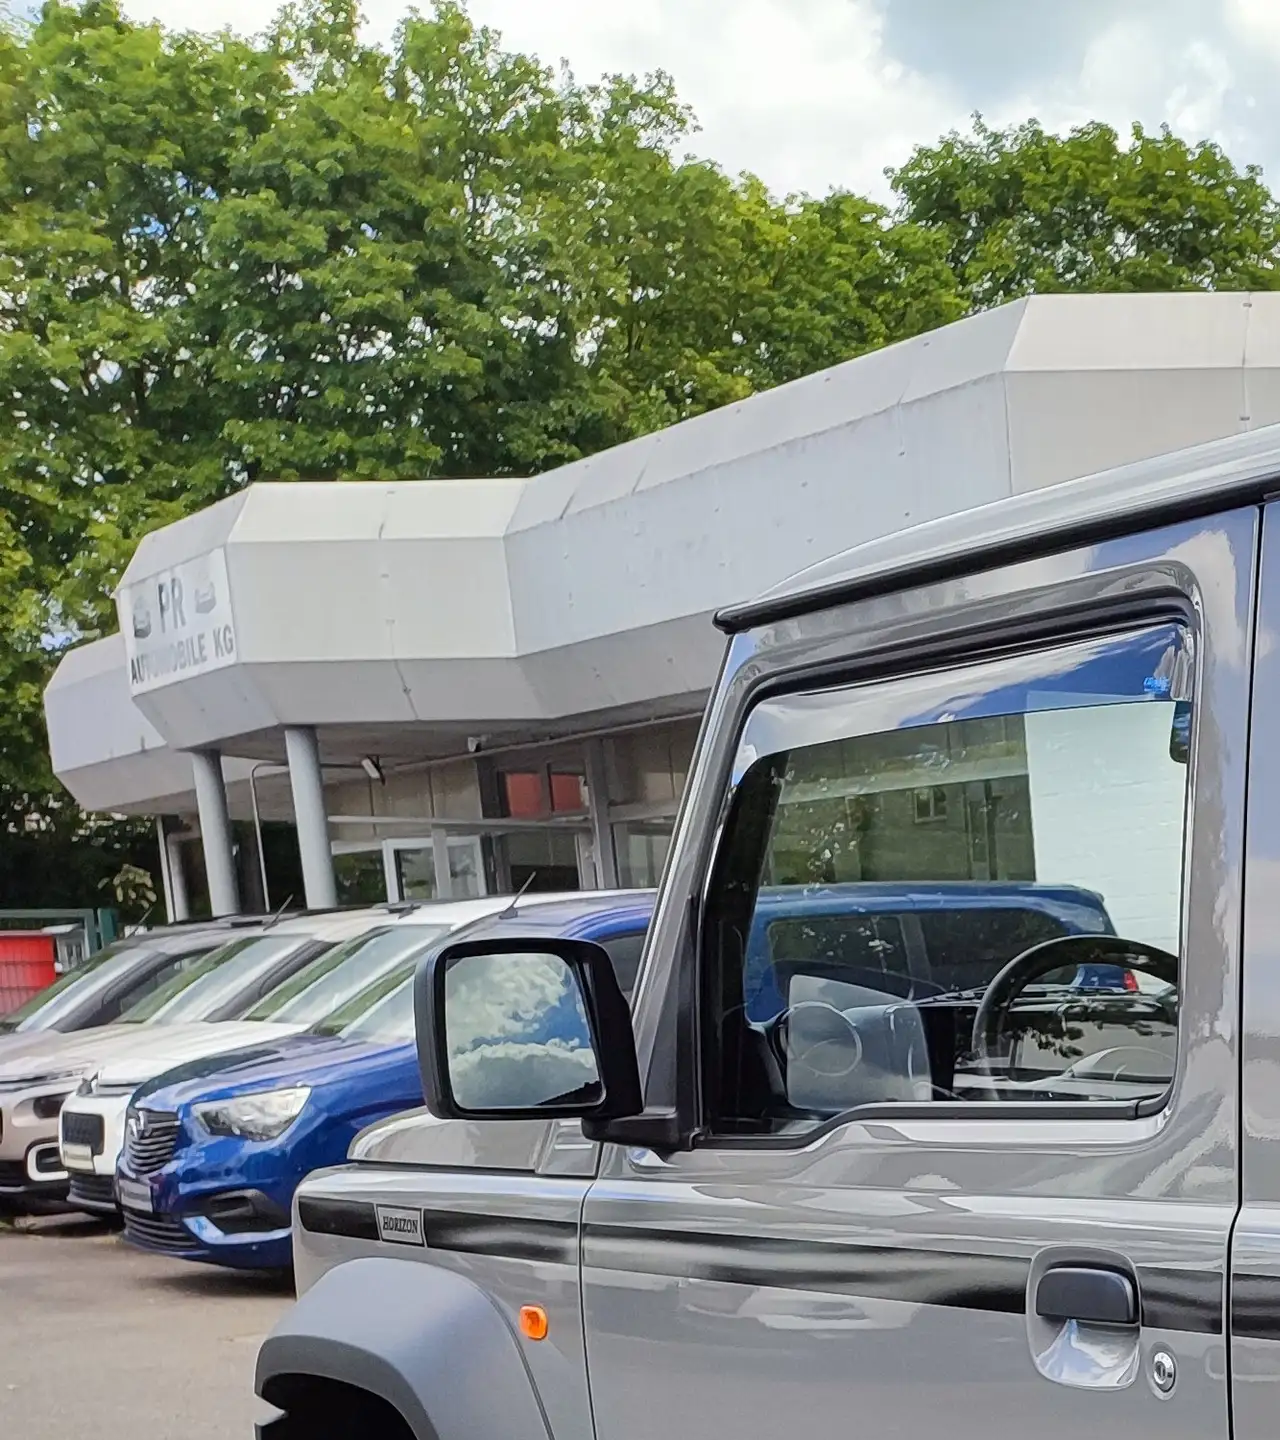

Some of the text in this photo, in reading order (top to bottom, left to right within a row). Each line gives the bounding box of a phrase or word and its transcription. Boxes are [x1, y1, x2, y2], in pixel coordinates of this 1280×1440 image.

[158, 577, 187, 634] PR
[212, 623, 234, 658] KG
[382, 1215, 419, 1234] HORIZON
